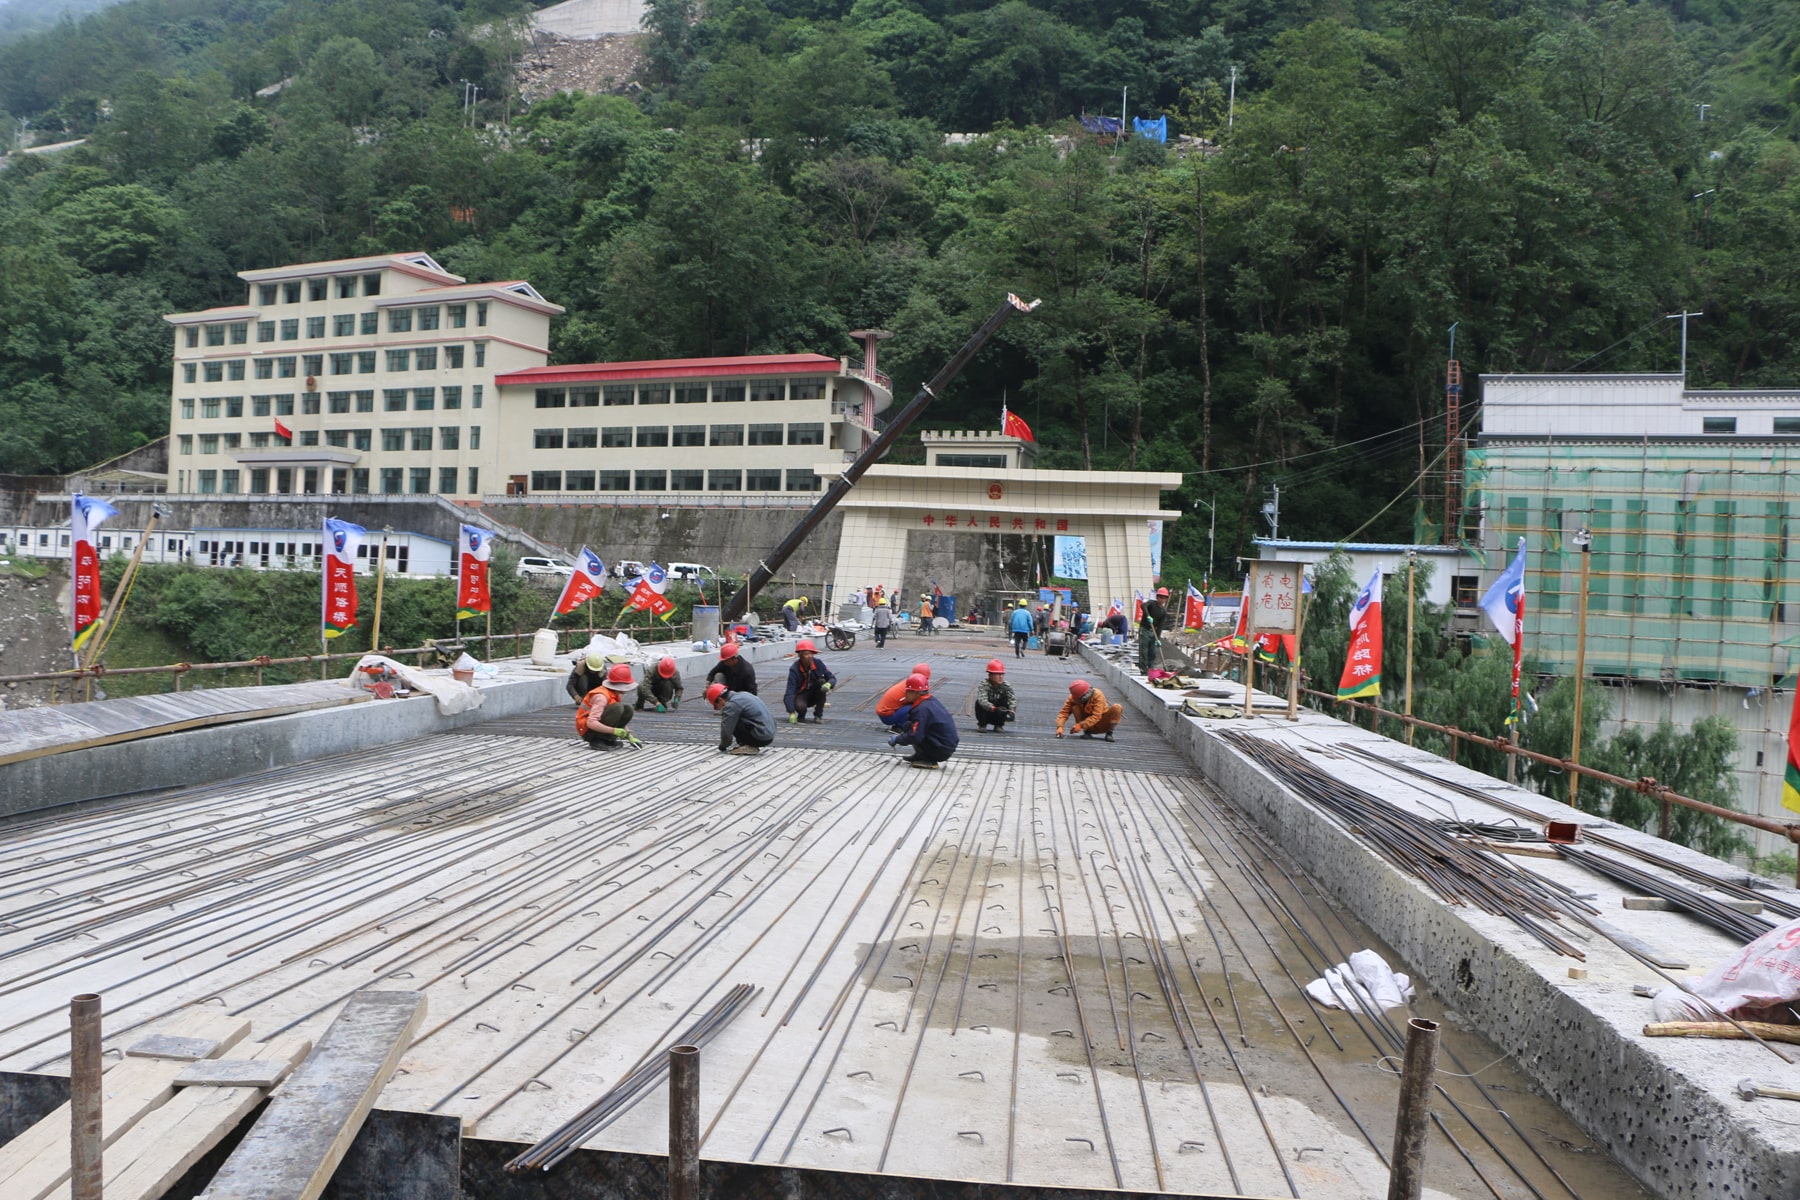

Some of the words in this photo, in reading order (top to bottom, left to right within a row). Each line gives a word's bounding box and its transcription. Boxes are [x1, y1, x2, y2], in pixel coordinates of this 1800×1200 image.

[923, 514, 1069, 531] 中华人民共和国
[1262, 571, 1293, 589] 有电
[333, 567, 349, 622] 天顺路桥
[1261, 592, 1294, 610] 危险
